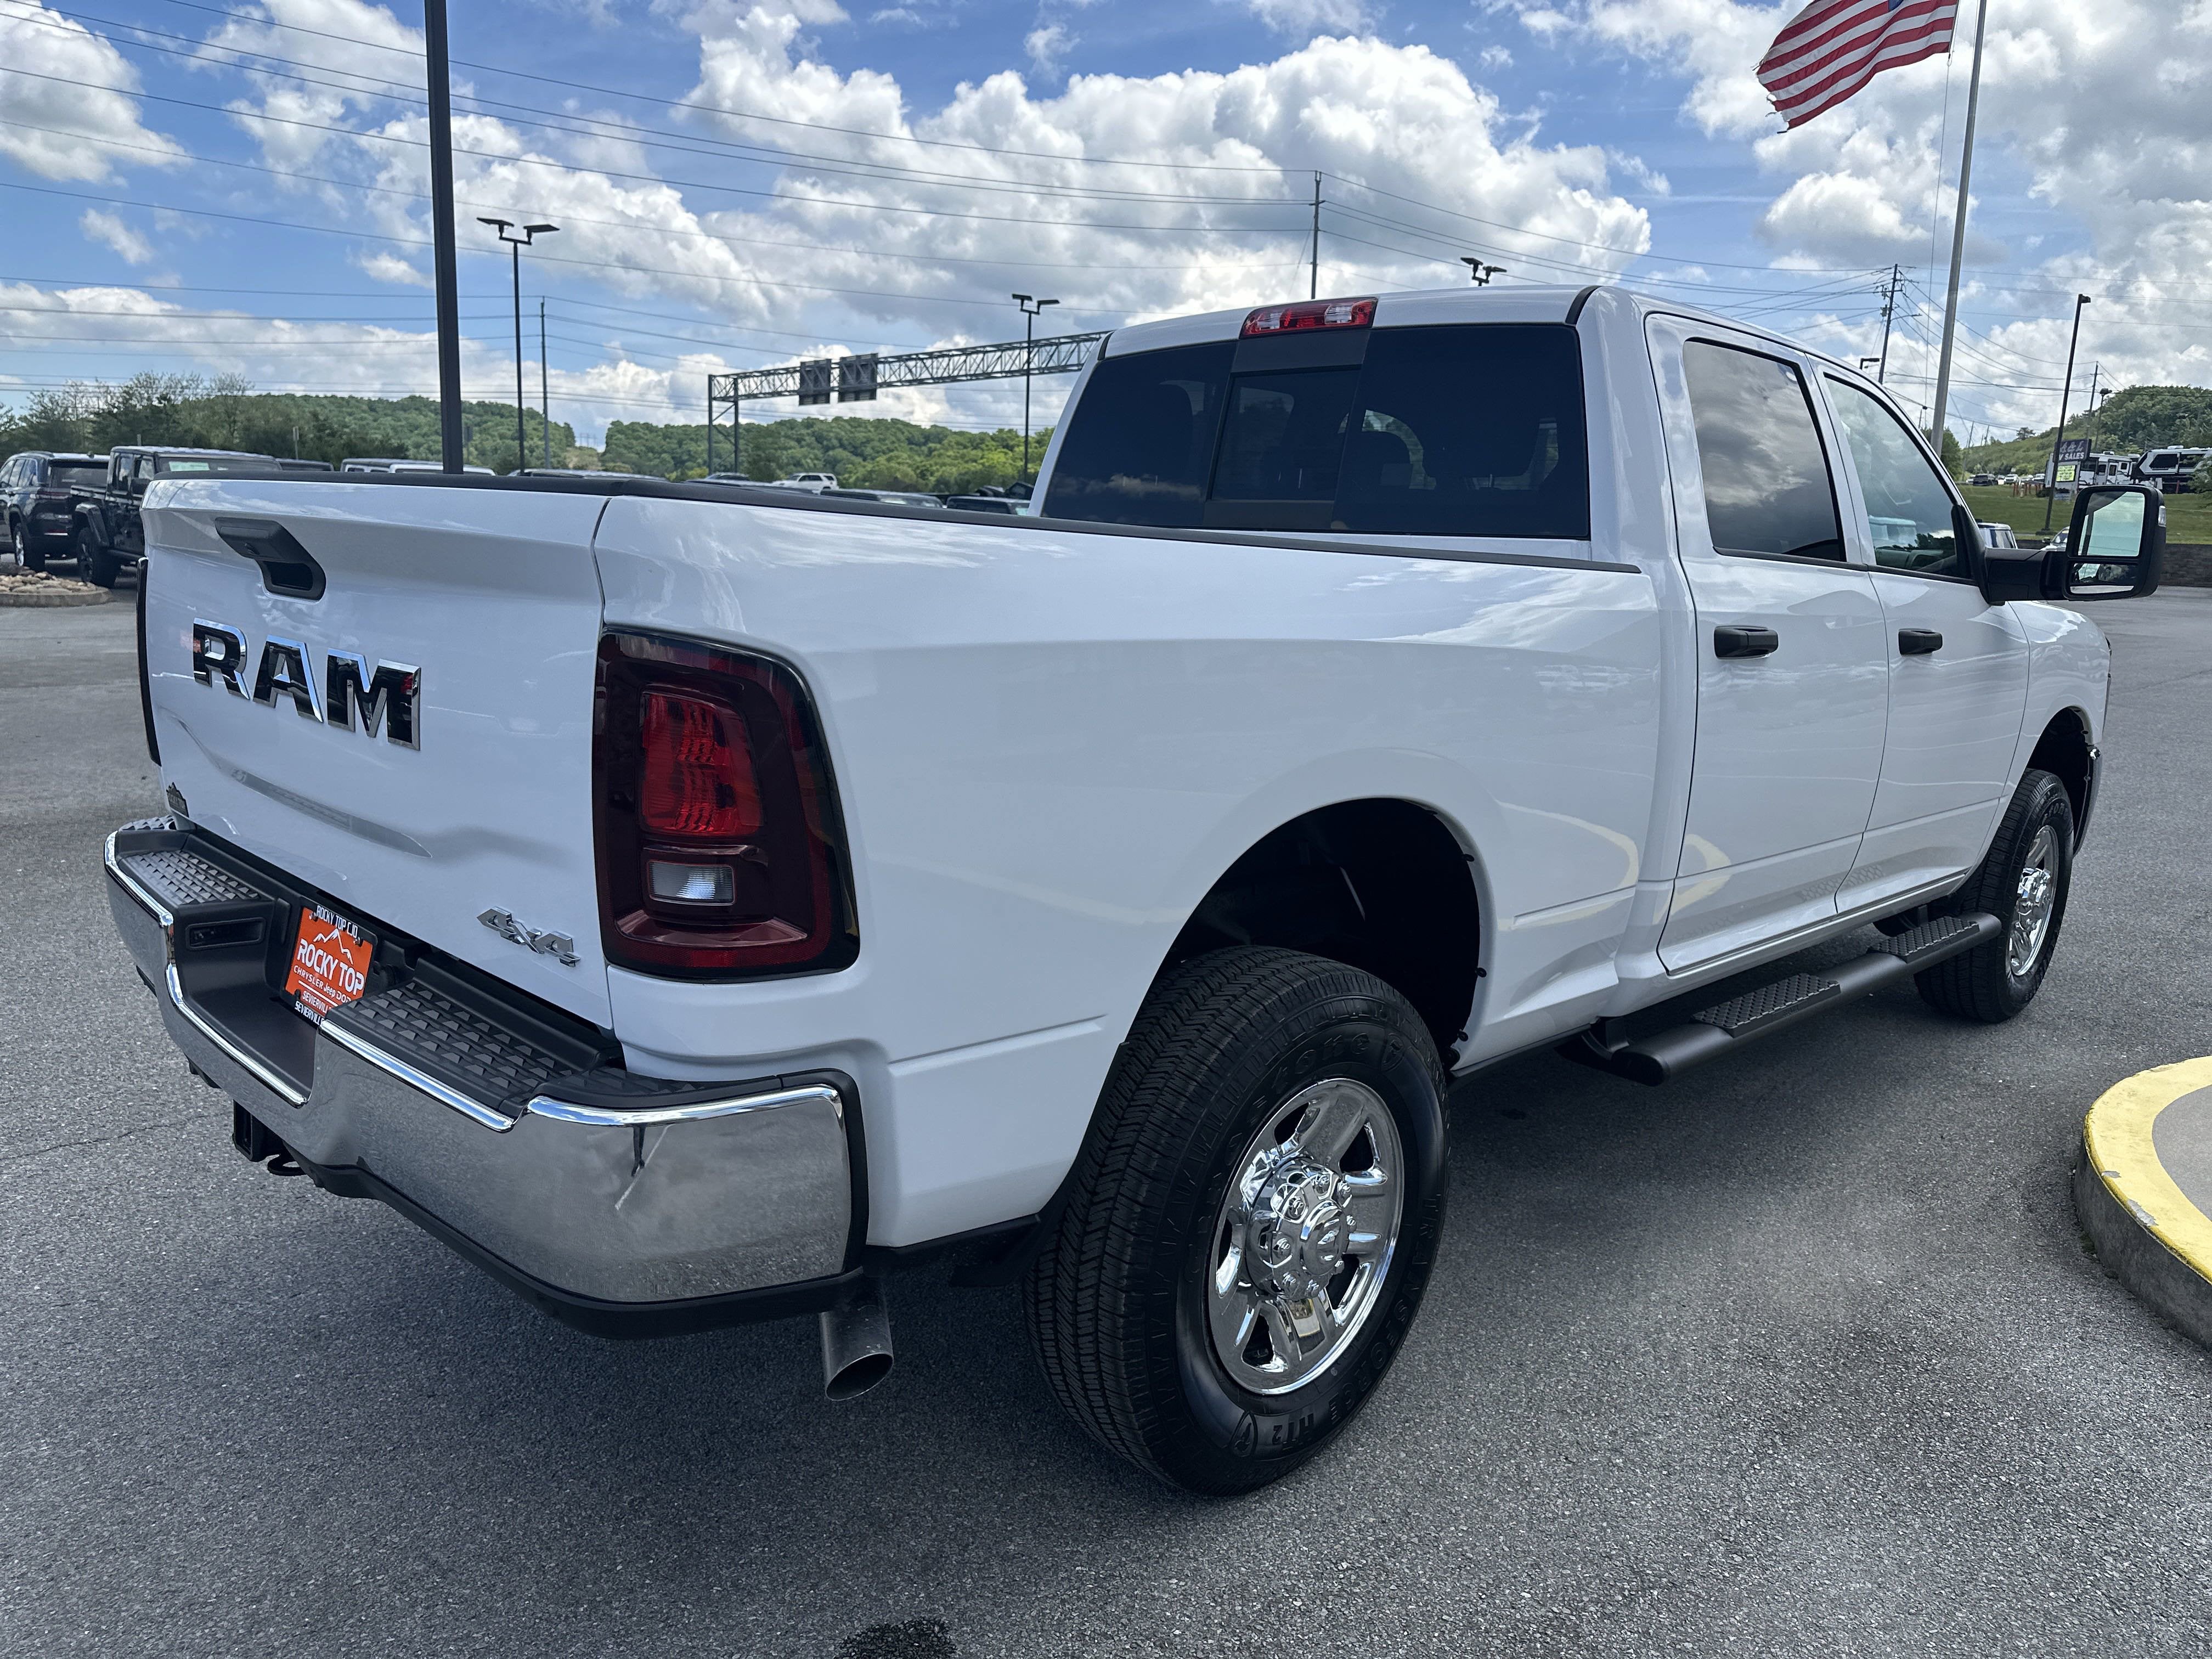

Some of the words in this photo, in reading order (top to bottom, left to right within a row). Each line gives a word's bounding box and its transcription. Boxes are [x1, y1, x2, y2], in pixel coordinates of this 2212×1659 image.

[2064, 452, 2085, 460] SALES
[193, 617, 421, 752] RAM
[316, 905, 335, 925] ROCKY
[335, 915, 346, 931] TOP
[294, 965, 324, 990] CHRYSLER
[323, 982, 336, 998] Jeep
[297, 938, 338, 981] ROCKY
[338, 961, 365, 996] TOP
[302, 990, 332, 1014] SEVIERVILL
